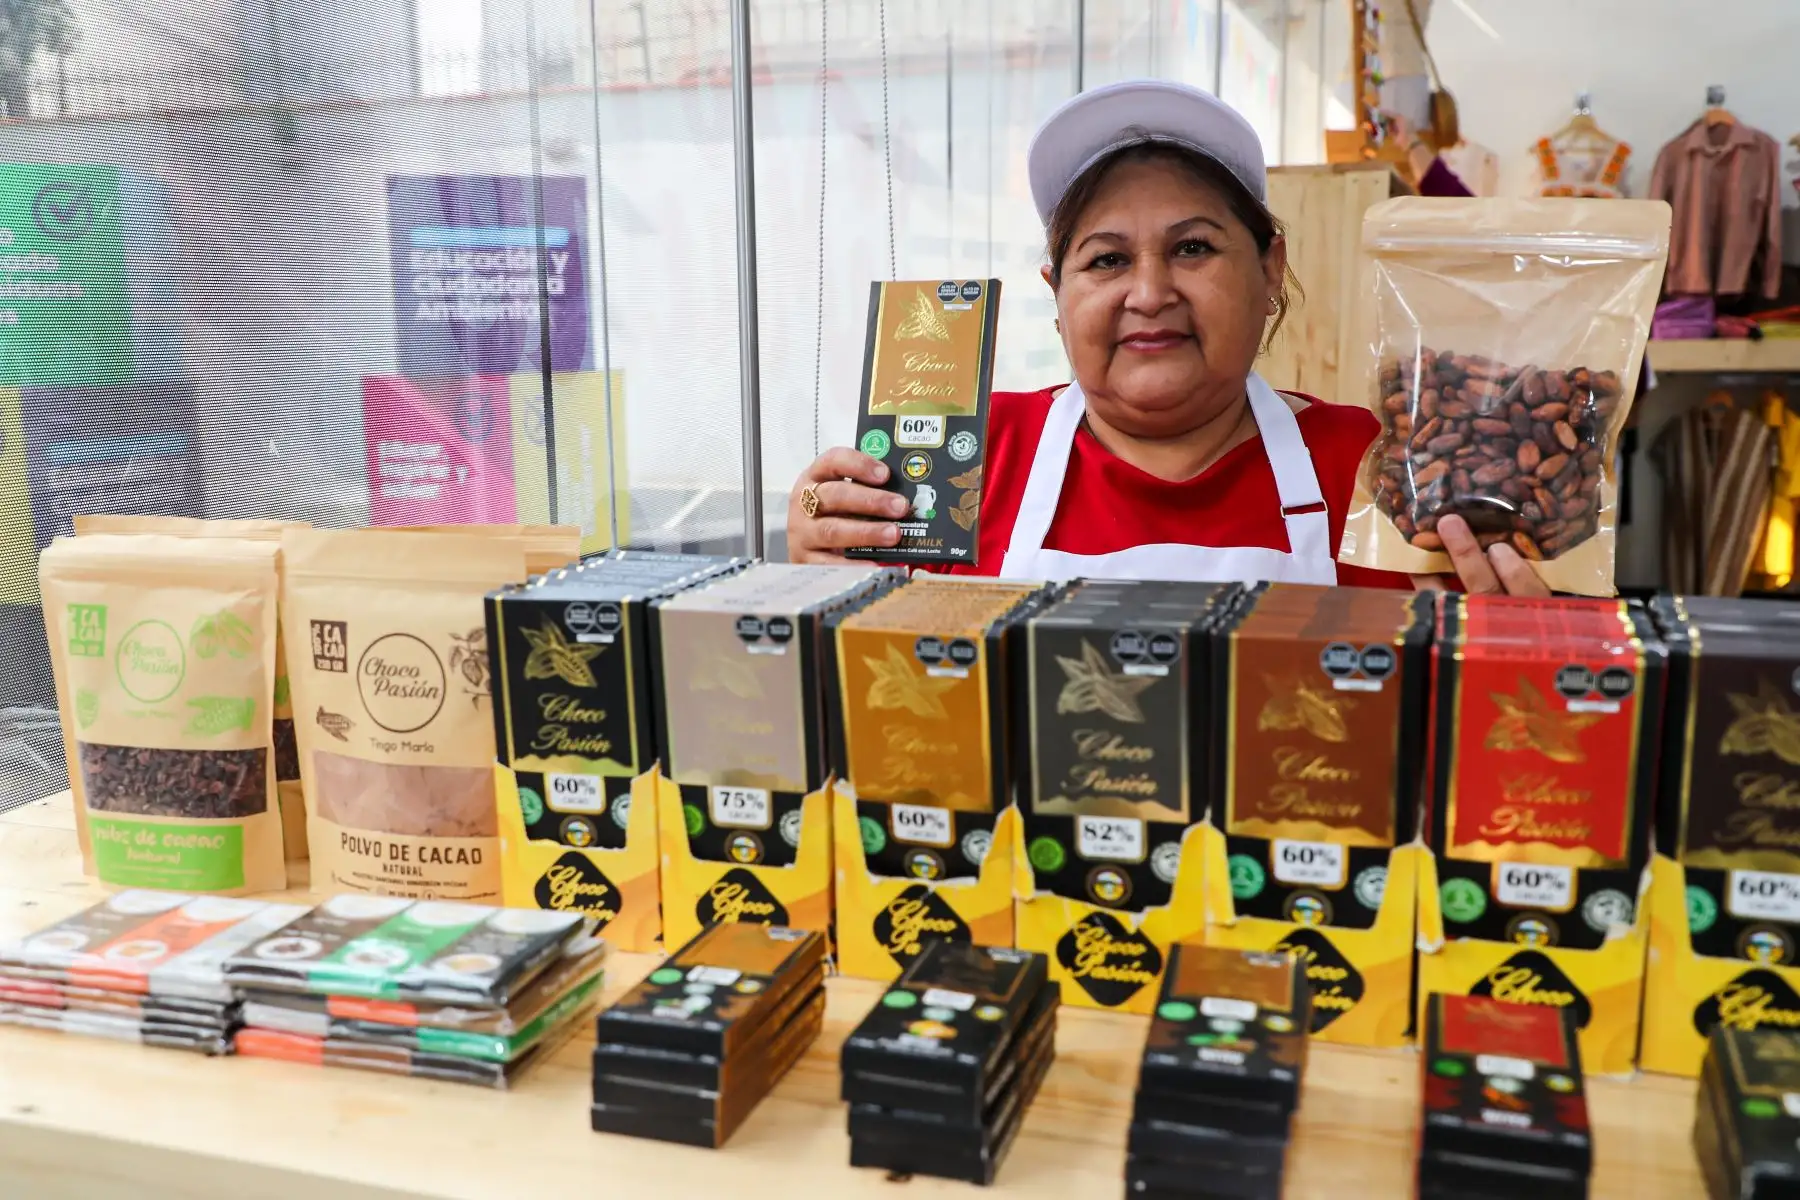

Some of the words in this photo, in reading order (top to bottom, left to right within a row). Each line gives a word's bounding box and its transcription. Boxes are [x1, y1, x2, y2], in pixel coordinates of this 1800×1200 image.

[409, 246, 540, 273] Educació
[412, 273, 566, 295] Ciudadana
[414, 298, 543, 321] Ambienta
[903, 419, 938, 433] 60%
[950, 548, 967, 557] 90gr
[364, 656, 420, 679] Choco
[374, 678, 439, 699] Pasión
[537, 692, 607, 723] Choco
[370, 737, 397, 753] Tingo
[530, 723, 611, 753] Pasión
[1071, 728, 1154, 761] Choco
[554, 777, 597, 796] 60%
[1060, 762, 1158, 795] Pasión
[719, 791, 765, 811] 75%
[897, 810, 946, 829] 60%
[135, 830, 158, 847] de
[1083, 822, 1136, 842] 82%
[341, 831, 383, 858] POLVO
[389, 842, 411, 862] DE
[418, 846, 483, 865] CACAO
[1282, 845, 1338, 867] 60%
[382, 863, 424, 877] NATURAL
[546, 864, 609, 897] Choco
[1506, 868, 1567, 890] 60%
[888, 897, 957, 933] Choco
[1072, 922, 1148, 956] Choco
[1072, 950, 1153, 984] Pasión
[1488, 965, 1576, 1006] Choco
